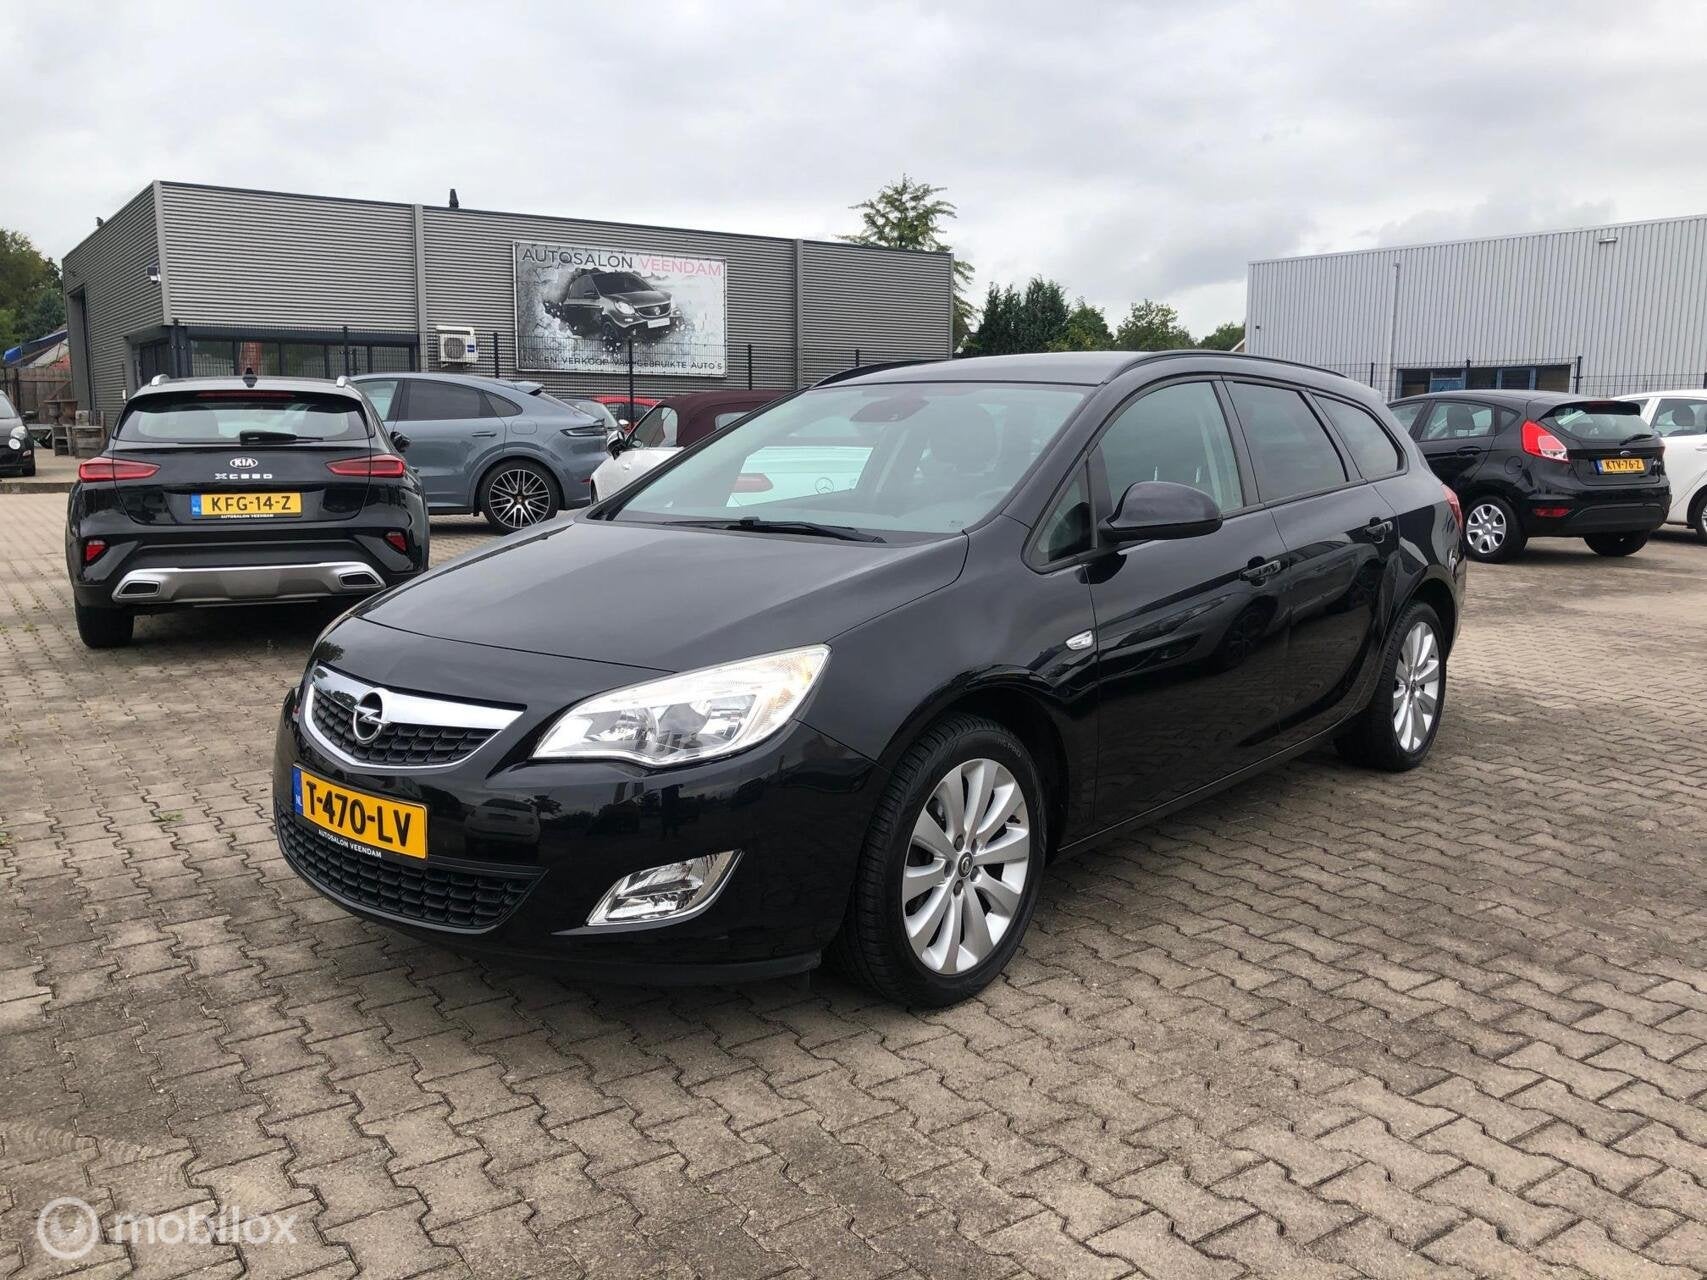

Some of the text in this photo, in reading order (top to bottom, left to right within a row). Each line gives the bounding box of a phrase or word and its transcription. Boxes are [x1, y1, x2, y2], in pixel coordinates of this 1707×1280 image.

[521, 249, 721, 276] AUTOSALON VEENDAM
[561, 357, 609, 365] VERKOOP
[636, 360, 687, 369] GEBRUIKTE
[234, 458, 254, 467] KIA
[1605, 460, 1642, 470] KTV-76-Z
[211, 495, 291, 511] KFG-14-Z
[305, 780, 412, 847] T-470-LV
[318, 829, 382, 858] AUTOSALON VEENDAM
